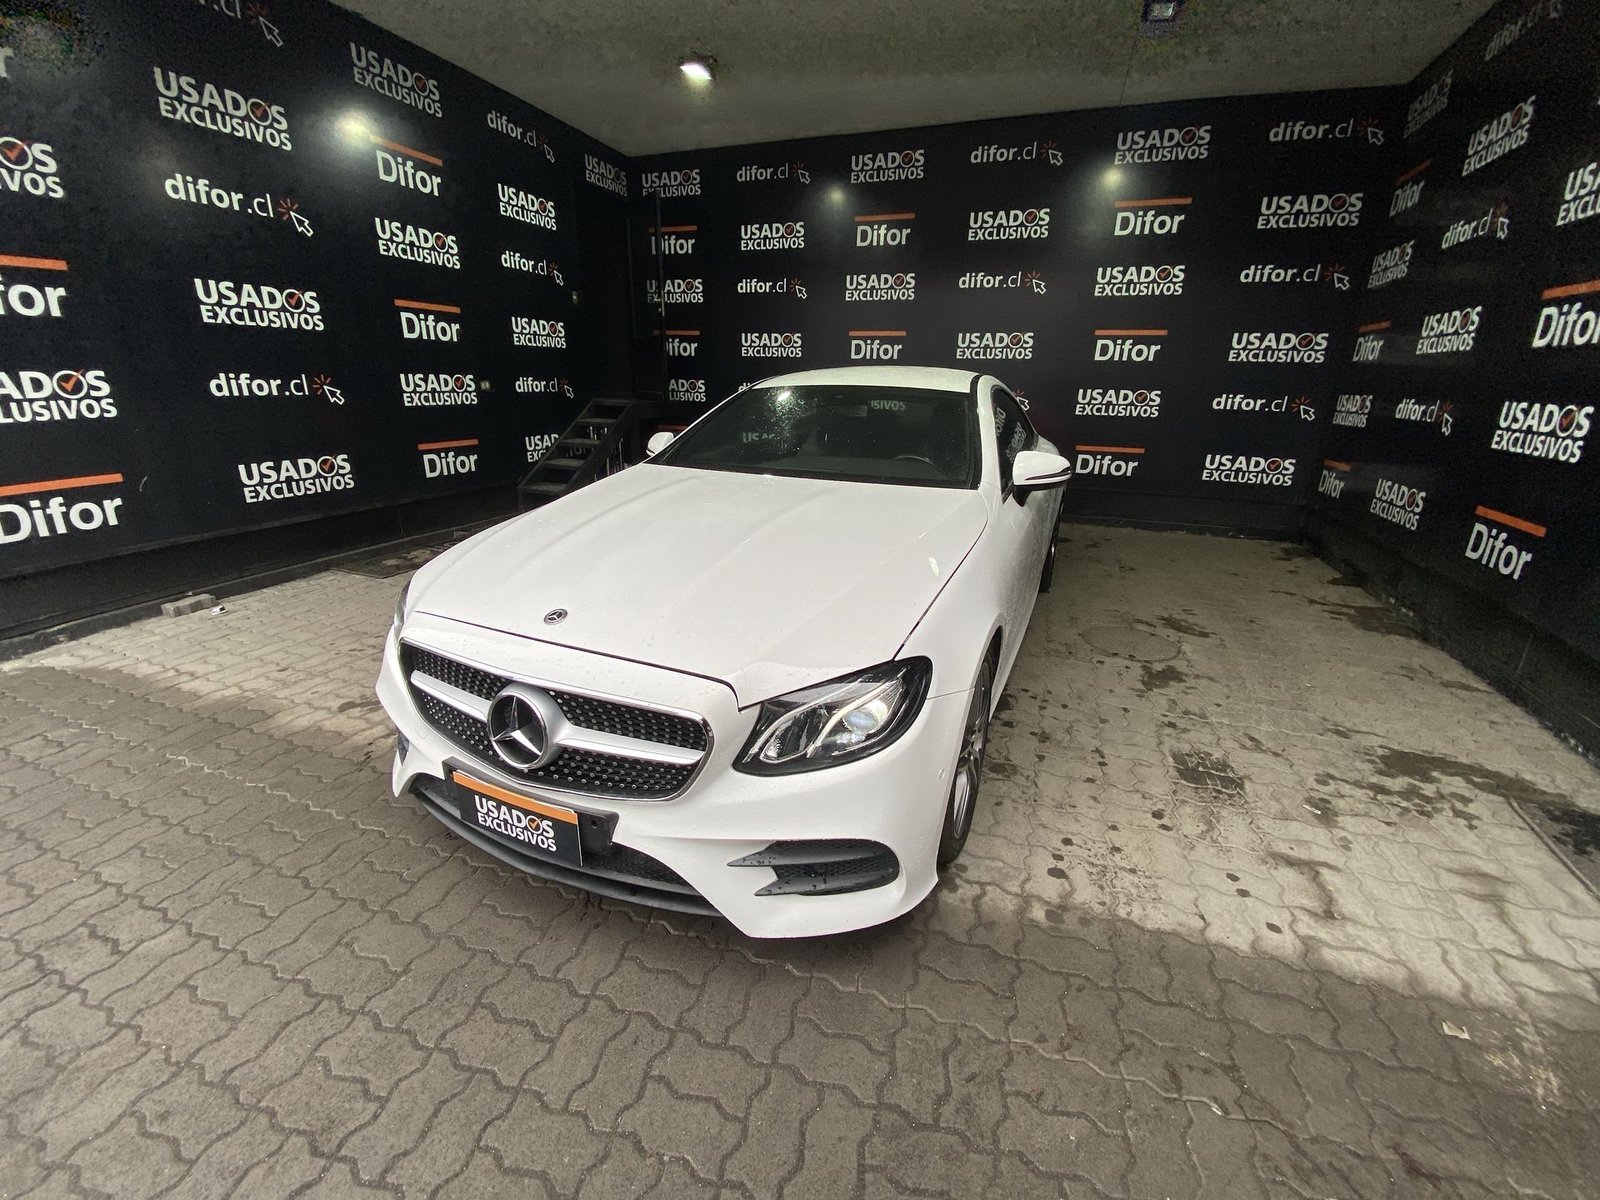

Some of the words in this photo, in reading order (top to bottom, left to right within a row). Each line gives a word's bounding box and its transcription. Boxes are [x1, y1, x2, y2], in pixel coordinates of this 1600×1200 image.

[350, 41, 440, 100] USADOS
[153, 67, 288, 130] USADOS
[353, 66, 443, 118] EXCLUSIVOS
[158, 96, 292, 151] EXCLUSIVOS
[487, 110, 536, 147] difor.cl
[1269, 118, 1354, 142] difor.cl
[1468, 95, 1536, 155] USADOS
[1116, 125, 1211, 150] USADOS
[851, 149, 925, 171] USADOS
[970, 141, 1037, 164] difor.cl
[1114, 145, 1208, 165] EXCLUSIVOS
[1462, 124, 1530, 176] EXCLUSIVOS
[376, 150, 441, 196] Difor
[585, 153, 627, 185] USADOS
[642, 169, 701, 188] USADOS
[737, 163, 789, 182] difor.cl
[850, 166, 924, 184] EXCLUSIVOS
[165, 173, 274, 218] difor.cl
[585, 171, 628, 198] EXCLUSIVOS
[497, 183, 555, 217] USADOS
[1260, 192, 1363, 215] USADOS
[1389, 180, 1424, 218] Difor
[500, 201, 557, 231] EXCLUSIVOS
[969, 208, 1050, 229] USADOS
[1114, 210, 1184, 236] Difor
[1256, 212, 1359, 230] EXCLUSIVOS
[375, 217, 459, 255] USADOS
[741, 221, 805, 239] USADOS
[856, 224, 911, 247] Difor
[968, 225, 1048, 241] EXCLUSIVOS
[1441, 207, 1493, 249] difor.cl
[378, 239, 460, 270] EXCLUSIVOS
[741, 236, 805, 250] EXCLUSIVOS
[501, 250, 547, 276] difor.cl
[1372, 240, 1414, 272] USADOS
[846, 273, 916, 290] USADOS
[958, 271, 1022, 289] difor.cl
[1096, 265, 1185, 284] USADOS
[1240, 264, 1321, 283] difor.cl
[1368, 261, 1409, 289] EXCLUSIVOS
[194, 278, 320, 313] USADOS
[737, 278, 787, 294] difor.cl
[845, 288, 915, 301] EXCLUSIVOS
[1094, 282, 1183, 297] EXCLUSIVOS
[200, 305, 324, 331] EXCLUSIVOS
[400, 312, 460, 342] Difor
[511, 316, 565, 337] USADOS
[1421, 305, 1482, 338] USADOS
[513, 333, 566, 349] EXCLUSIVOS
[666, 338, 698, 356] ifor
[741, 332, 802, 347] USADOS
[851, 339, 902, 360] Difor
[957, 332, 1034, 348] USADOS
[1094, 339, 1161, 362] Difor
[1231, 332, 1329, 350] USADOS
[1352, 335, 1384, 362] Difor
[1416, 333, 1475, 355] EXCLUSIVOS
[741, 347, 802, 358] EXCLUSIVOS
[956, 348, 1033, 360] EXCLUSIVOS
[1228, 350, 1325, 363] EXCLUSIVOS
[0, 370, 110, 399] ADOS
[209, 373, 309, 397] difor.cl
[400, 373, 475, 392] USADOS
[515, 377, 558, 393] difor.cl
[669, 379, 706, 393] ADOS
[403, 392, 478, 407] EXCLUSIVOS
[669, 391, 707, 402] LUSIVOS
[1077, 389, 1161, 405] USADOS
[1212, 393, 1288, 412] difor.cl
[1336, 394, 1372, 413] USADOS
[0, 398, 117, 424] LUSIVOS
[1075, 405, 1159, 418] EXCLUSIVOS
[1332, 411, 1368, 428] EXCLUSIVOS
[1395, 399, 1440, 423] difor.cl
[1498, 401, 1594, 438] USADOS
[1490, 429, 1584, 464] EXCLUSIVOS
[238, 454, 350, 485] USADOS
[423, 452, 478, 478] Difor
[1075, 454, 1139, 477] Difor
[1204, 454, 1296, 475] USADOS
[243, 474, 355, 504] EXCLUSIVOS
[1201, 470, 1292, 486] EXCLUSIVOS
[1318, 469, 1345, 499] Difor
[1375, 478, 1426, 514] USADOS
[0, 497, 123, 544] Difor
[1370, 499, 1420, 531] EXCLUSIVOS
[1465, 522, 1532, 580] Difor
[474, 795, 555, 838] USADOS
[477, 811, 557, 851] EXCLUSIVOS
